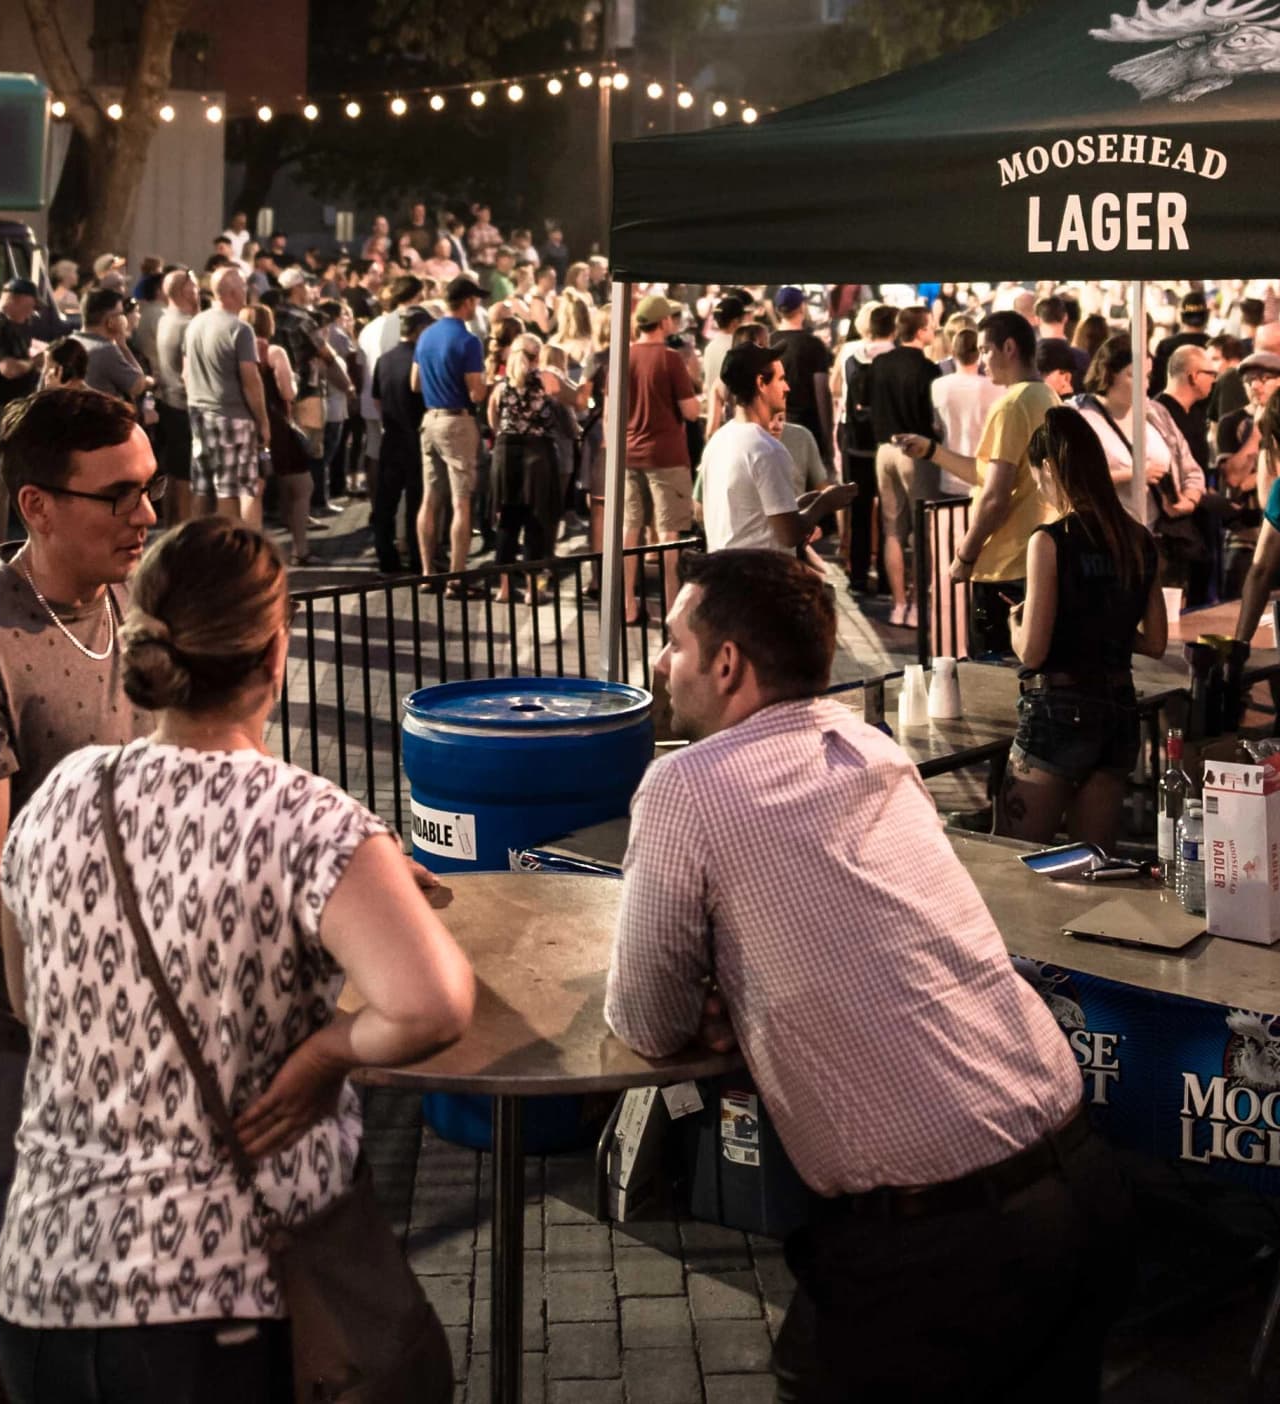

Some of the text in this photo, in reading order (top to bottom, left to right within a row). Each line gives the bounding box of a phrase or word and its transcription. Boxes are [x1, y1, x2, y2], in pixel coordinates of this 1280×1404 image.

[997, 133, 1228, 187] MOOSEHEAD
[1028, 192, 1190, 253] LAGER
[1213, 840, 1226, 889] RADLER
